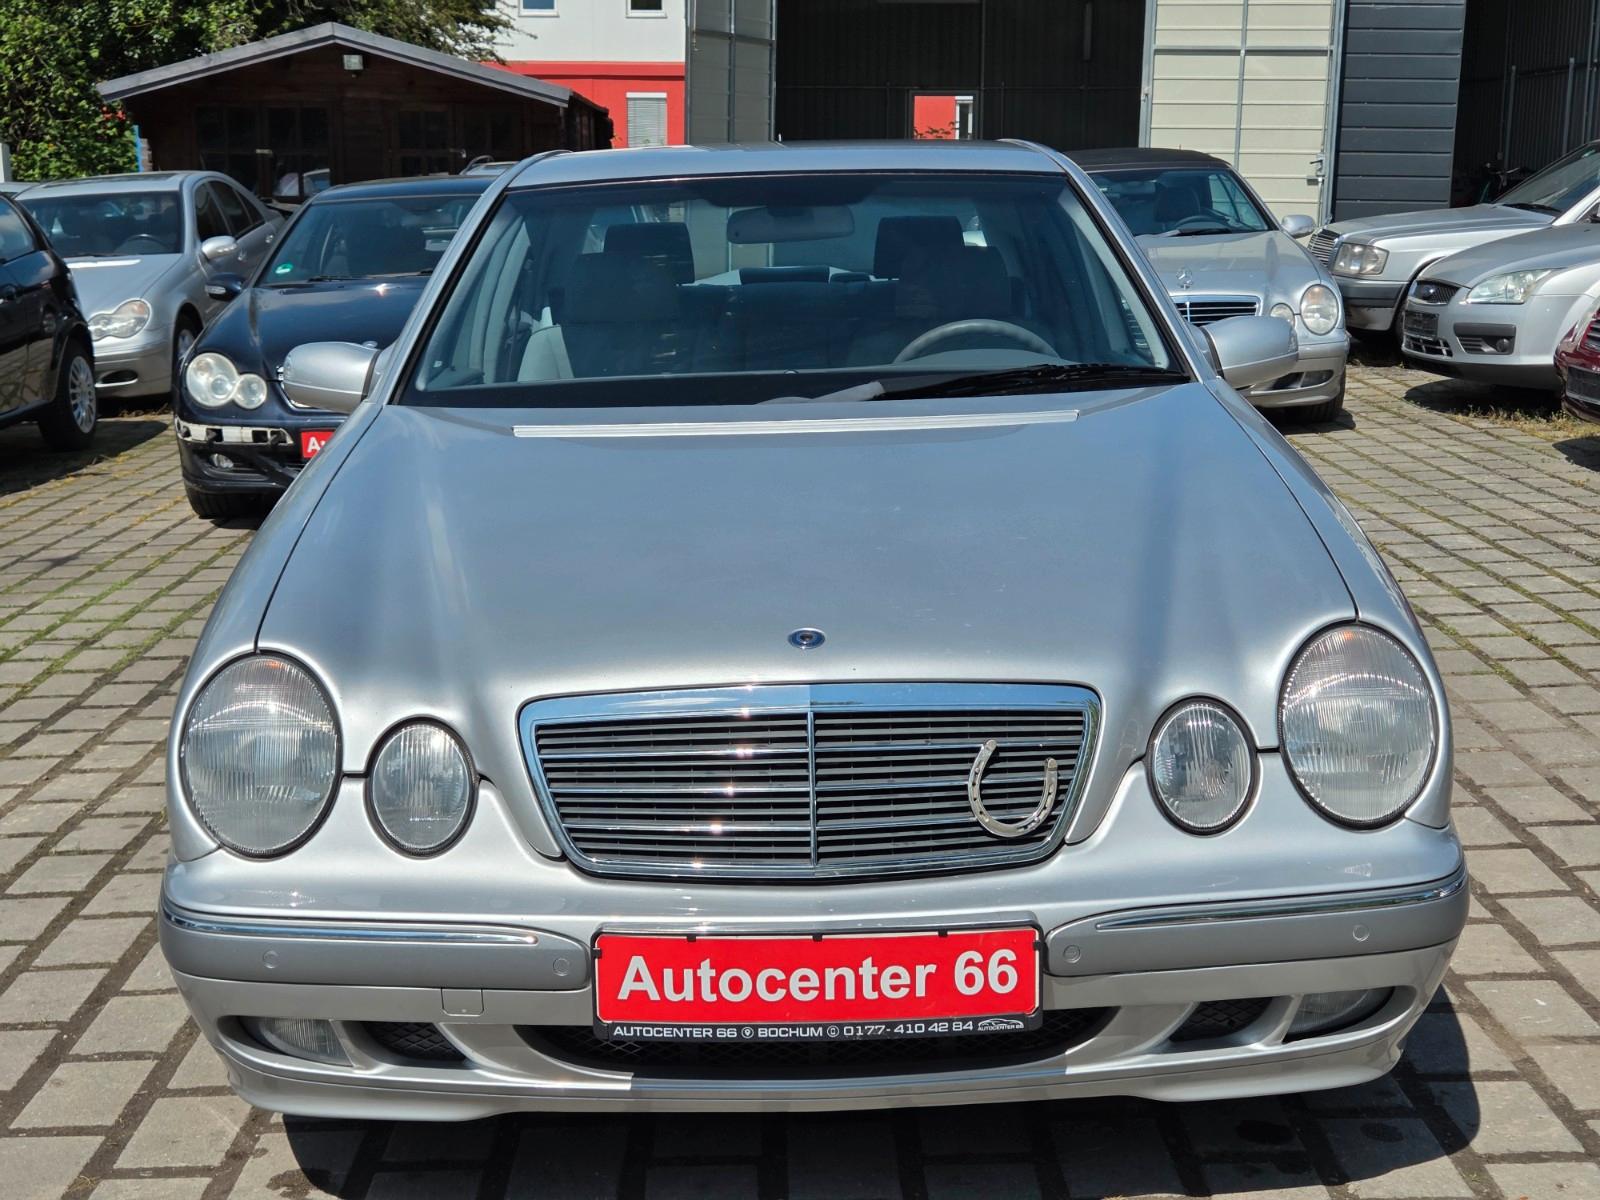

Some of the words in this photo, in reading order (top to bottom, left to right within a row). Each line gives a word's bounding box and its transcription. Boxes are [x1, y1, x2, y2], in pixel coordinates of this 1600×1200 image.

[617, 955, 937, 1002] Autocenter
[954, 949, 1018, 996] 66
[613, 1026, 713, 1038] AUTOCENTER
[716, 1027, 738, 1038] 66
[757, 1027, 823, 1038] BOCHUM
[927, 1022, 949, 1033] 42
[952, 1021, 973, 1032] 84
